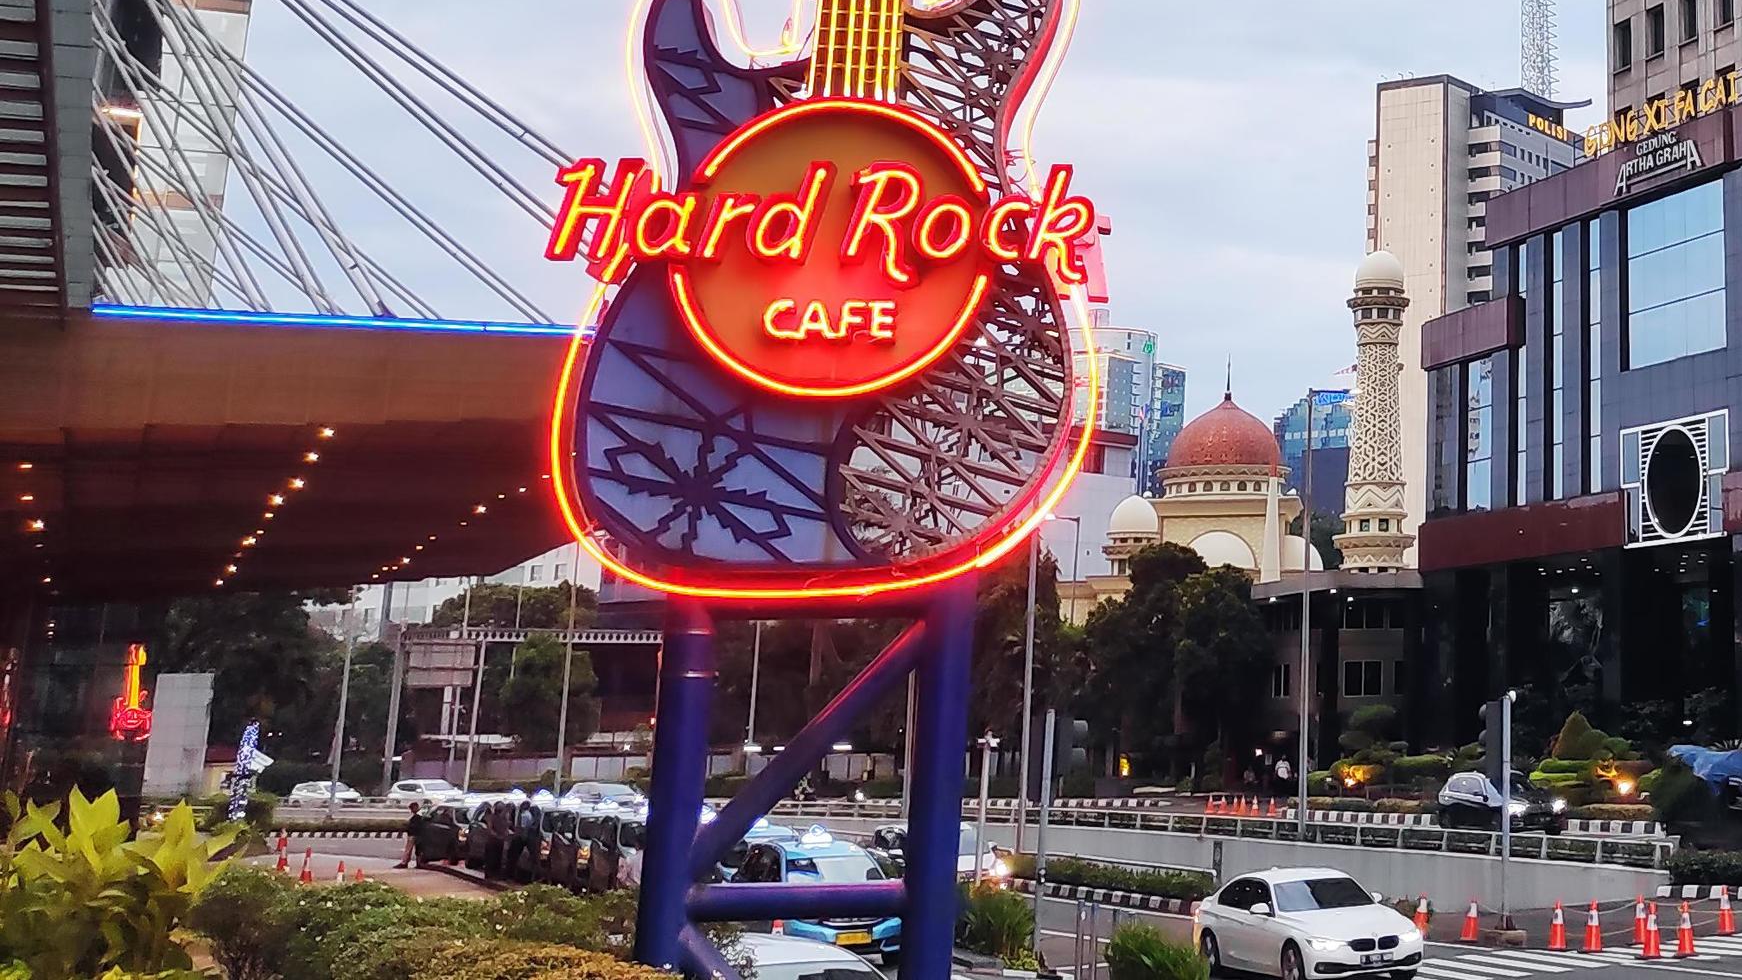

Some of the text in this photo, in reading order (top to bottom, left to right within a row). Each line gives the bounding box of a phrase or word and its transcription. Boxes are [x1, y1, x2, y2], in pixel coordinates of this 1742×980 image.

[1528, 113, 1568, 141] POLISI
[1643, 99, 1669, 135] XI
[1673, 89, 1696, 123] FA
[1700, 71, 1740, 112] CAI
[1614, 139, 1702, 196] ARTHA GRAHA
[1636, 131, 1677, 156] GEDUNG
[545, 157, 1095, 286] Hard Rock
[762, 298, 896, 340] CAFE
